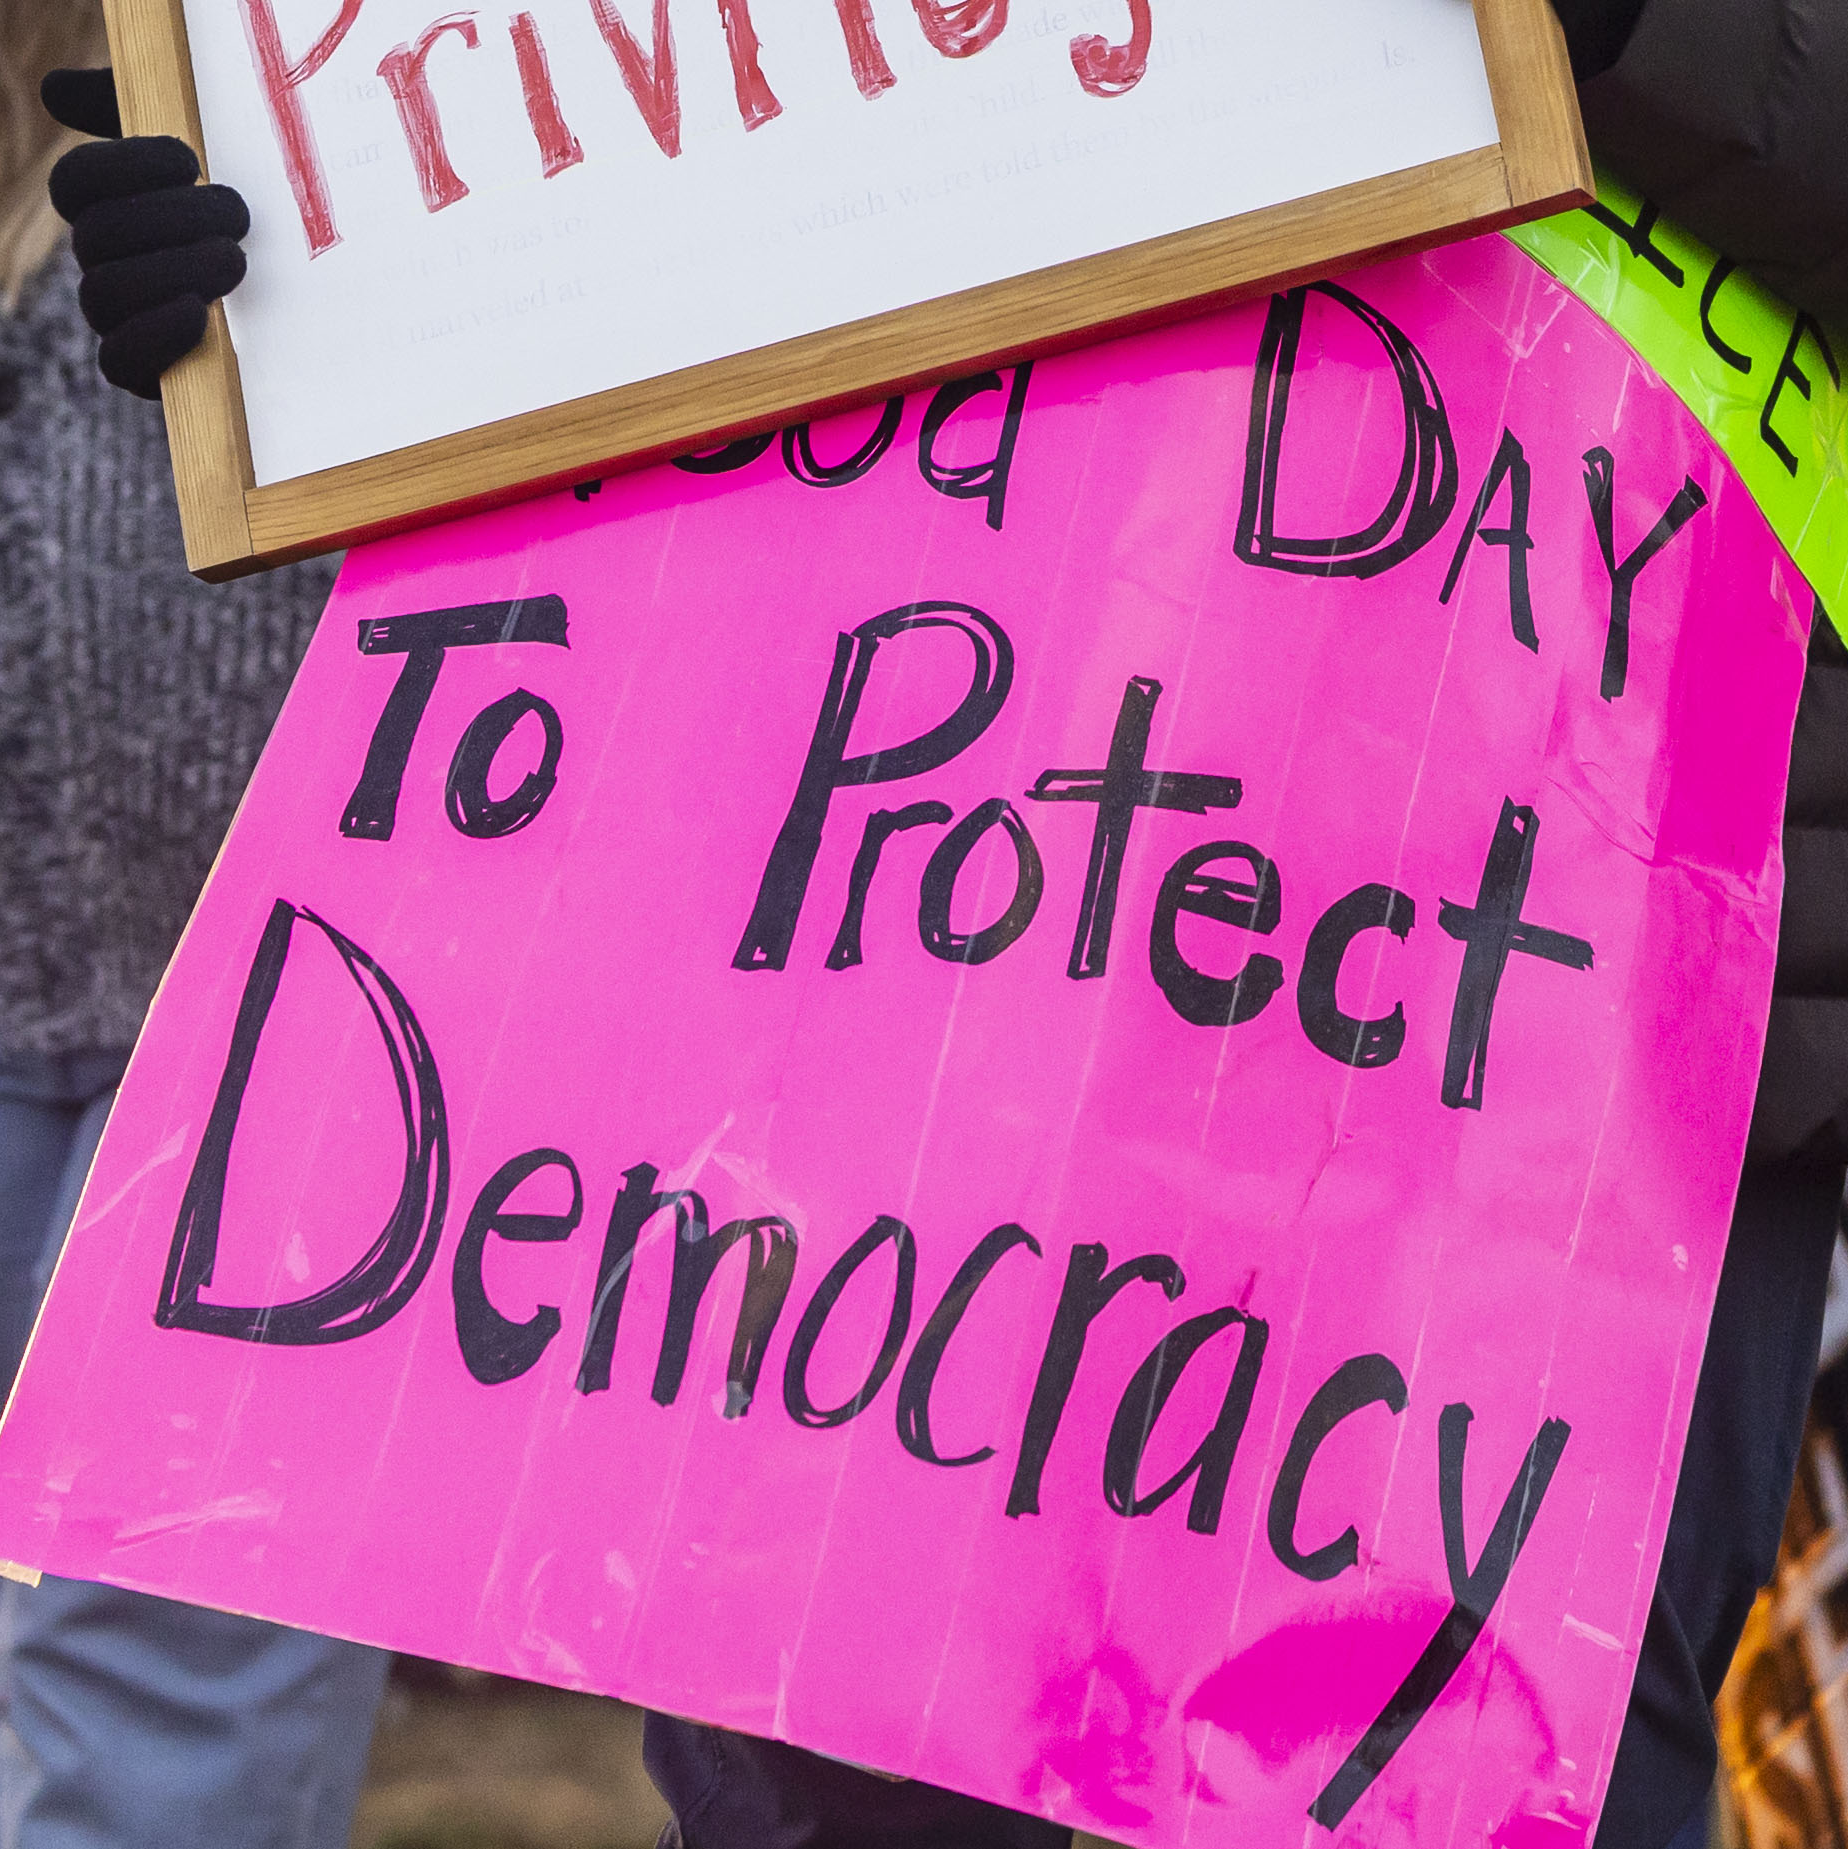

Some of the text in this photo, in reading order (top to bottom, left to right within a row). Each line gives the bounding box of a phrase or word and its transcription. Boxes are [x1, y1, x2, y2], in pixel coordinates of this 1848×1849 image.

[1233, 280, 1708, 703] DAY
[339, 593, 1595, 1111] To Protect
[153, 898, 1572, 1832] Democracy
